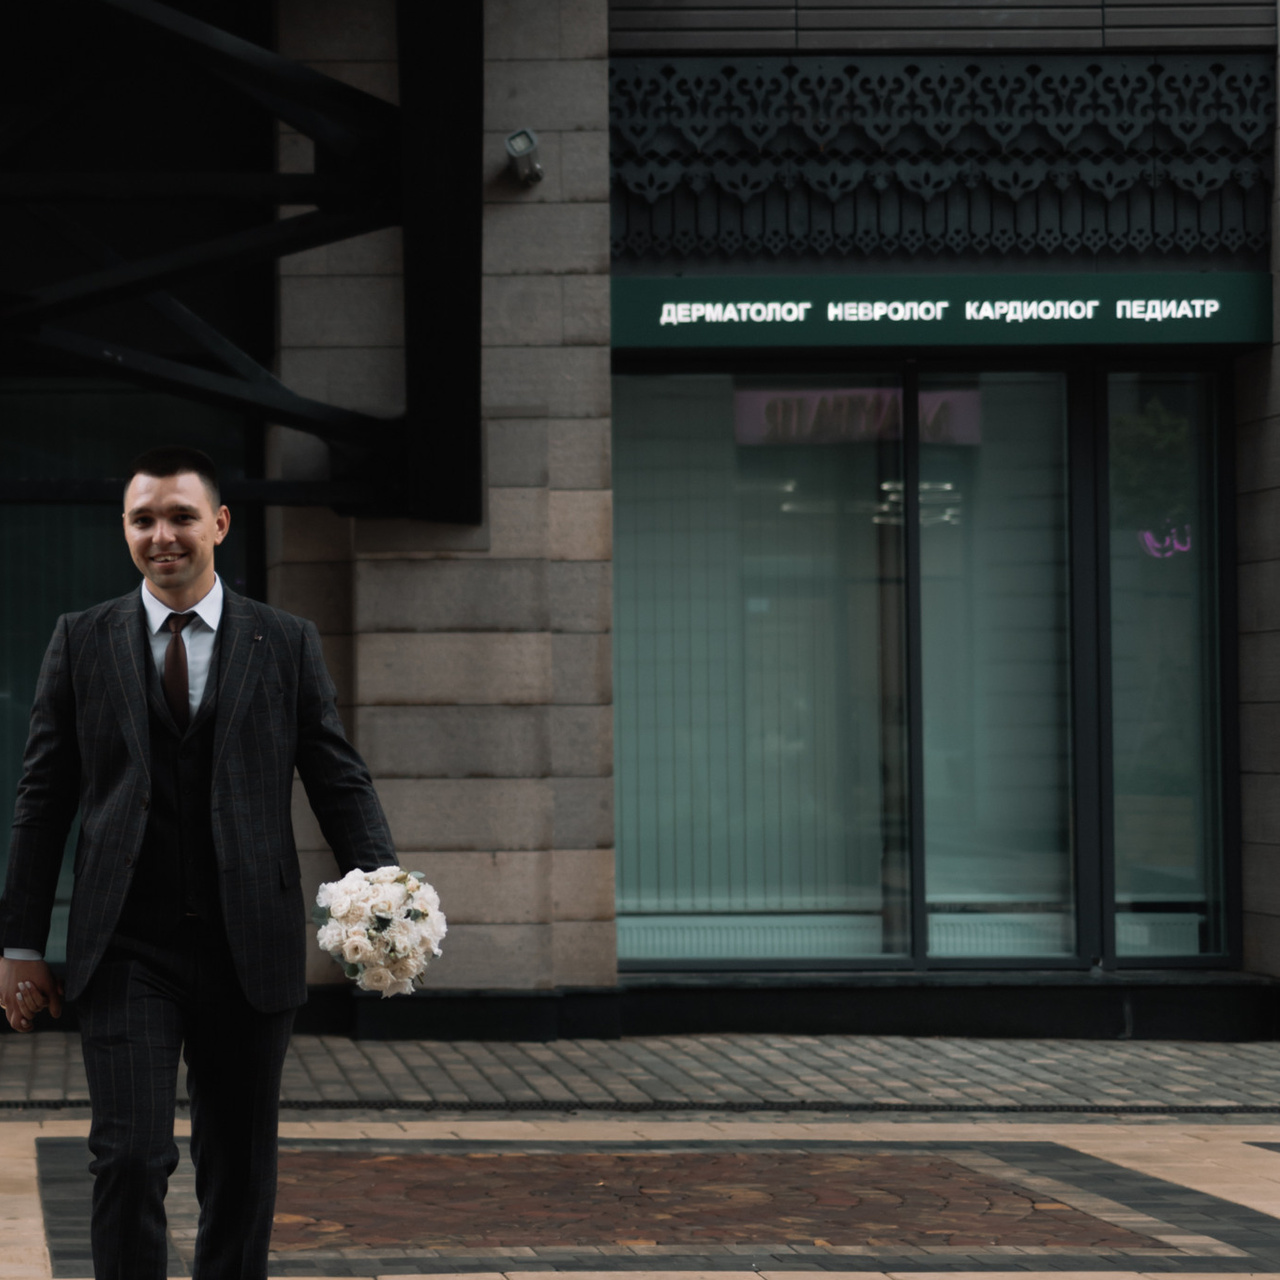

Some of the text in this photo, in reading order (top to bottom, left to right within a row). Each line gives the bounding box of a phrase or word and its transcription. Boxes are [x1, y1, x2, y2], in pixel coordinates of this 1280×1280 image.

[660, 299, 1220, 325] ДЕРМАТОЛОГ НЕВРОЛОГ КАРДИОЛОГ ПЕДИАТР
